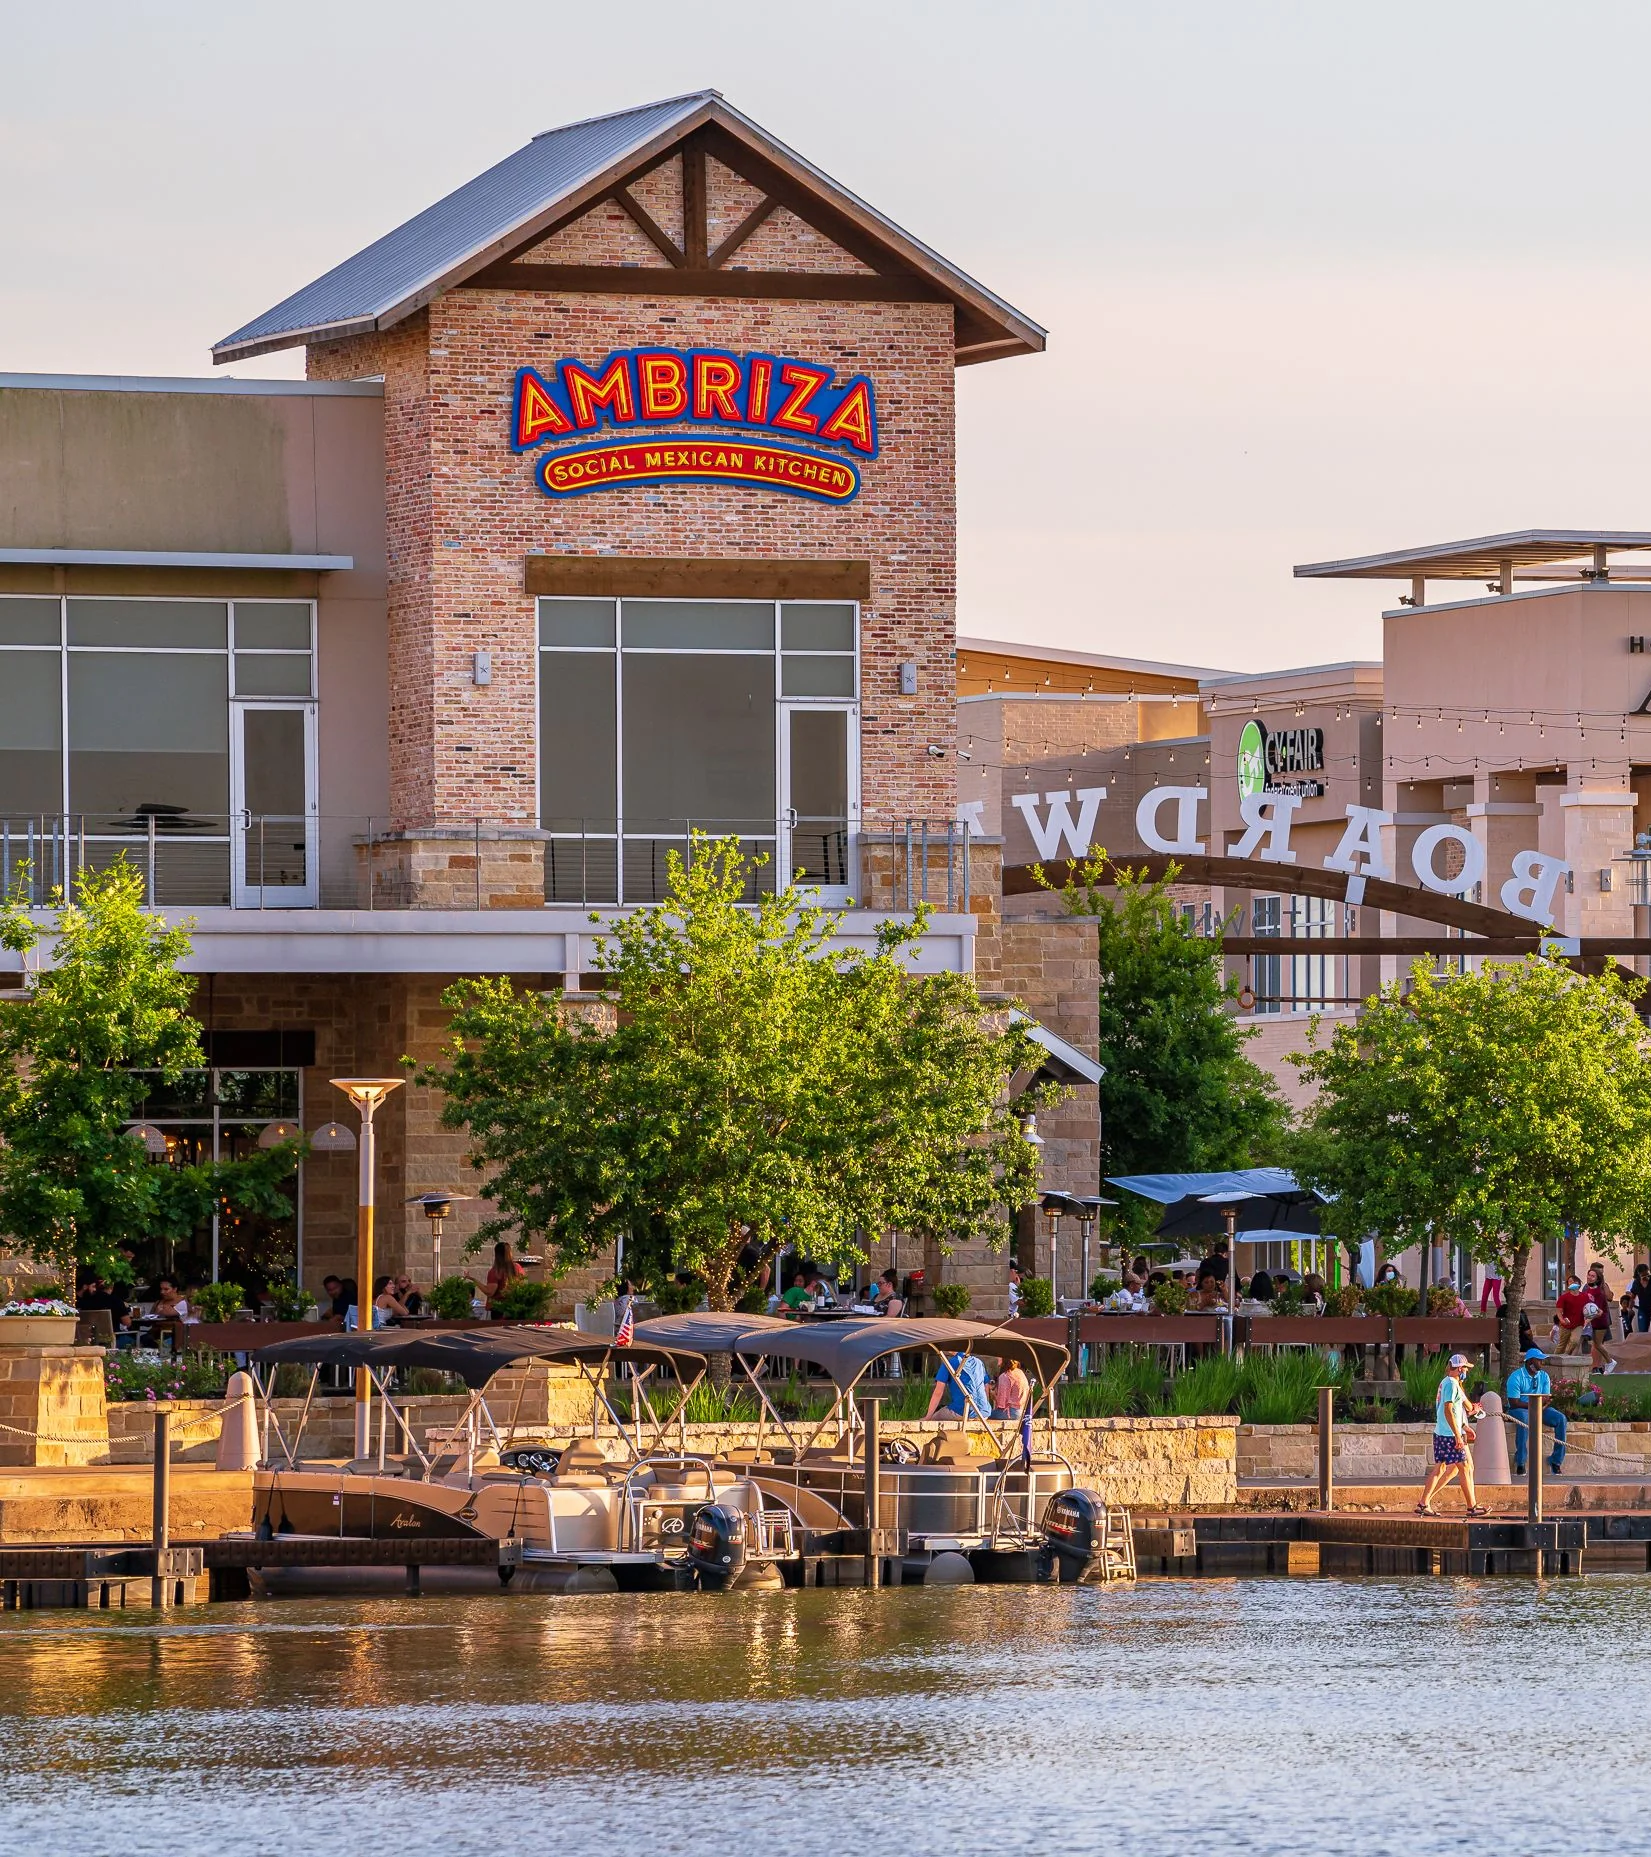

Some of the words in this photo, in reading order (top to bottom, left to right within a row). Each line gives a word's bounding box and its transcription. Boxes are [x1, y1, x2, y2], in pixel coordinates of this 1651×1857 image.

[517, 354, 875, 454] AMBRIZA
[553, 455, 635, 482] SOCIAL
[645, 450, 744, 470] MEXICAN
[753, 456, 848, 488] KITCHEN
[1301, 780, 1318, 798] union
[390, 1513, 421, 1529] Avalon
[1060, 1509, 1080, 1519] YAMAHA
